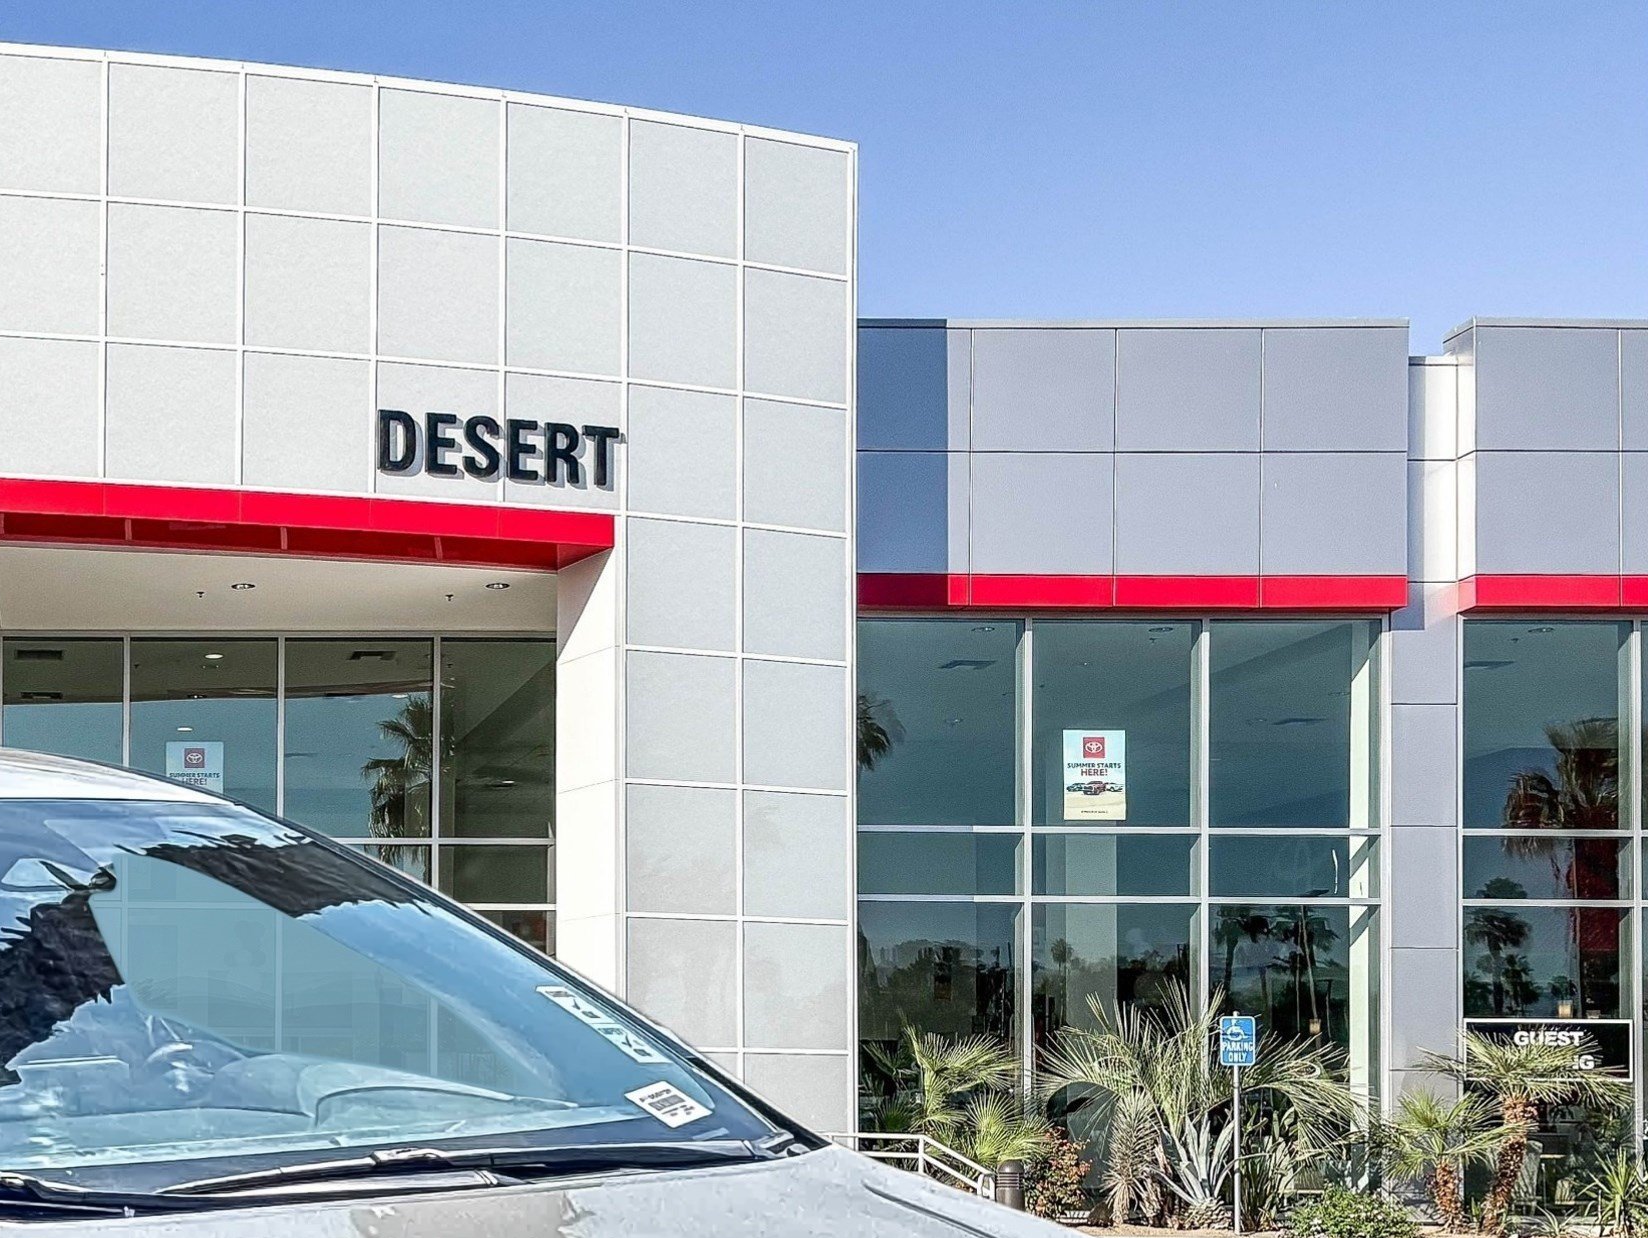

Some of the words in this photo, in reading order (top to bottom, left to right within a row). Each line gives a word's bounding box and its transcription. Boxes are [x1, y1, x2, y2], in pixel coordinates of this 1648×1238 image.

[377, 409, 620, 487] DESERT
[1513, 1031, 1584, 1047] GUEST
[1221, 1041, 1254, 1052] PARKING
[1228, 1052, 1248, 1062] ONLY
